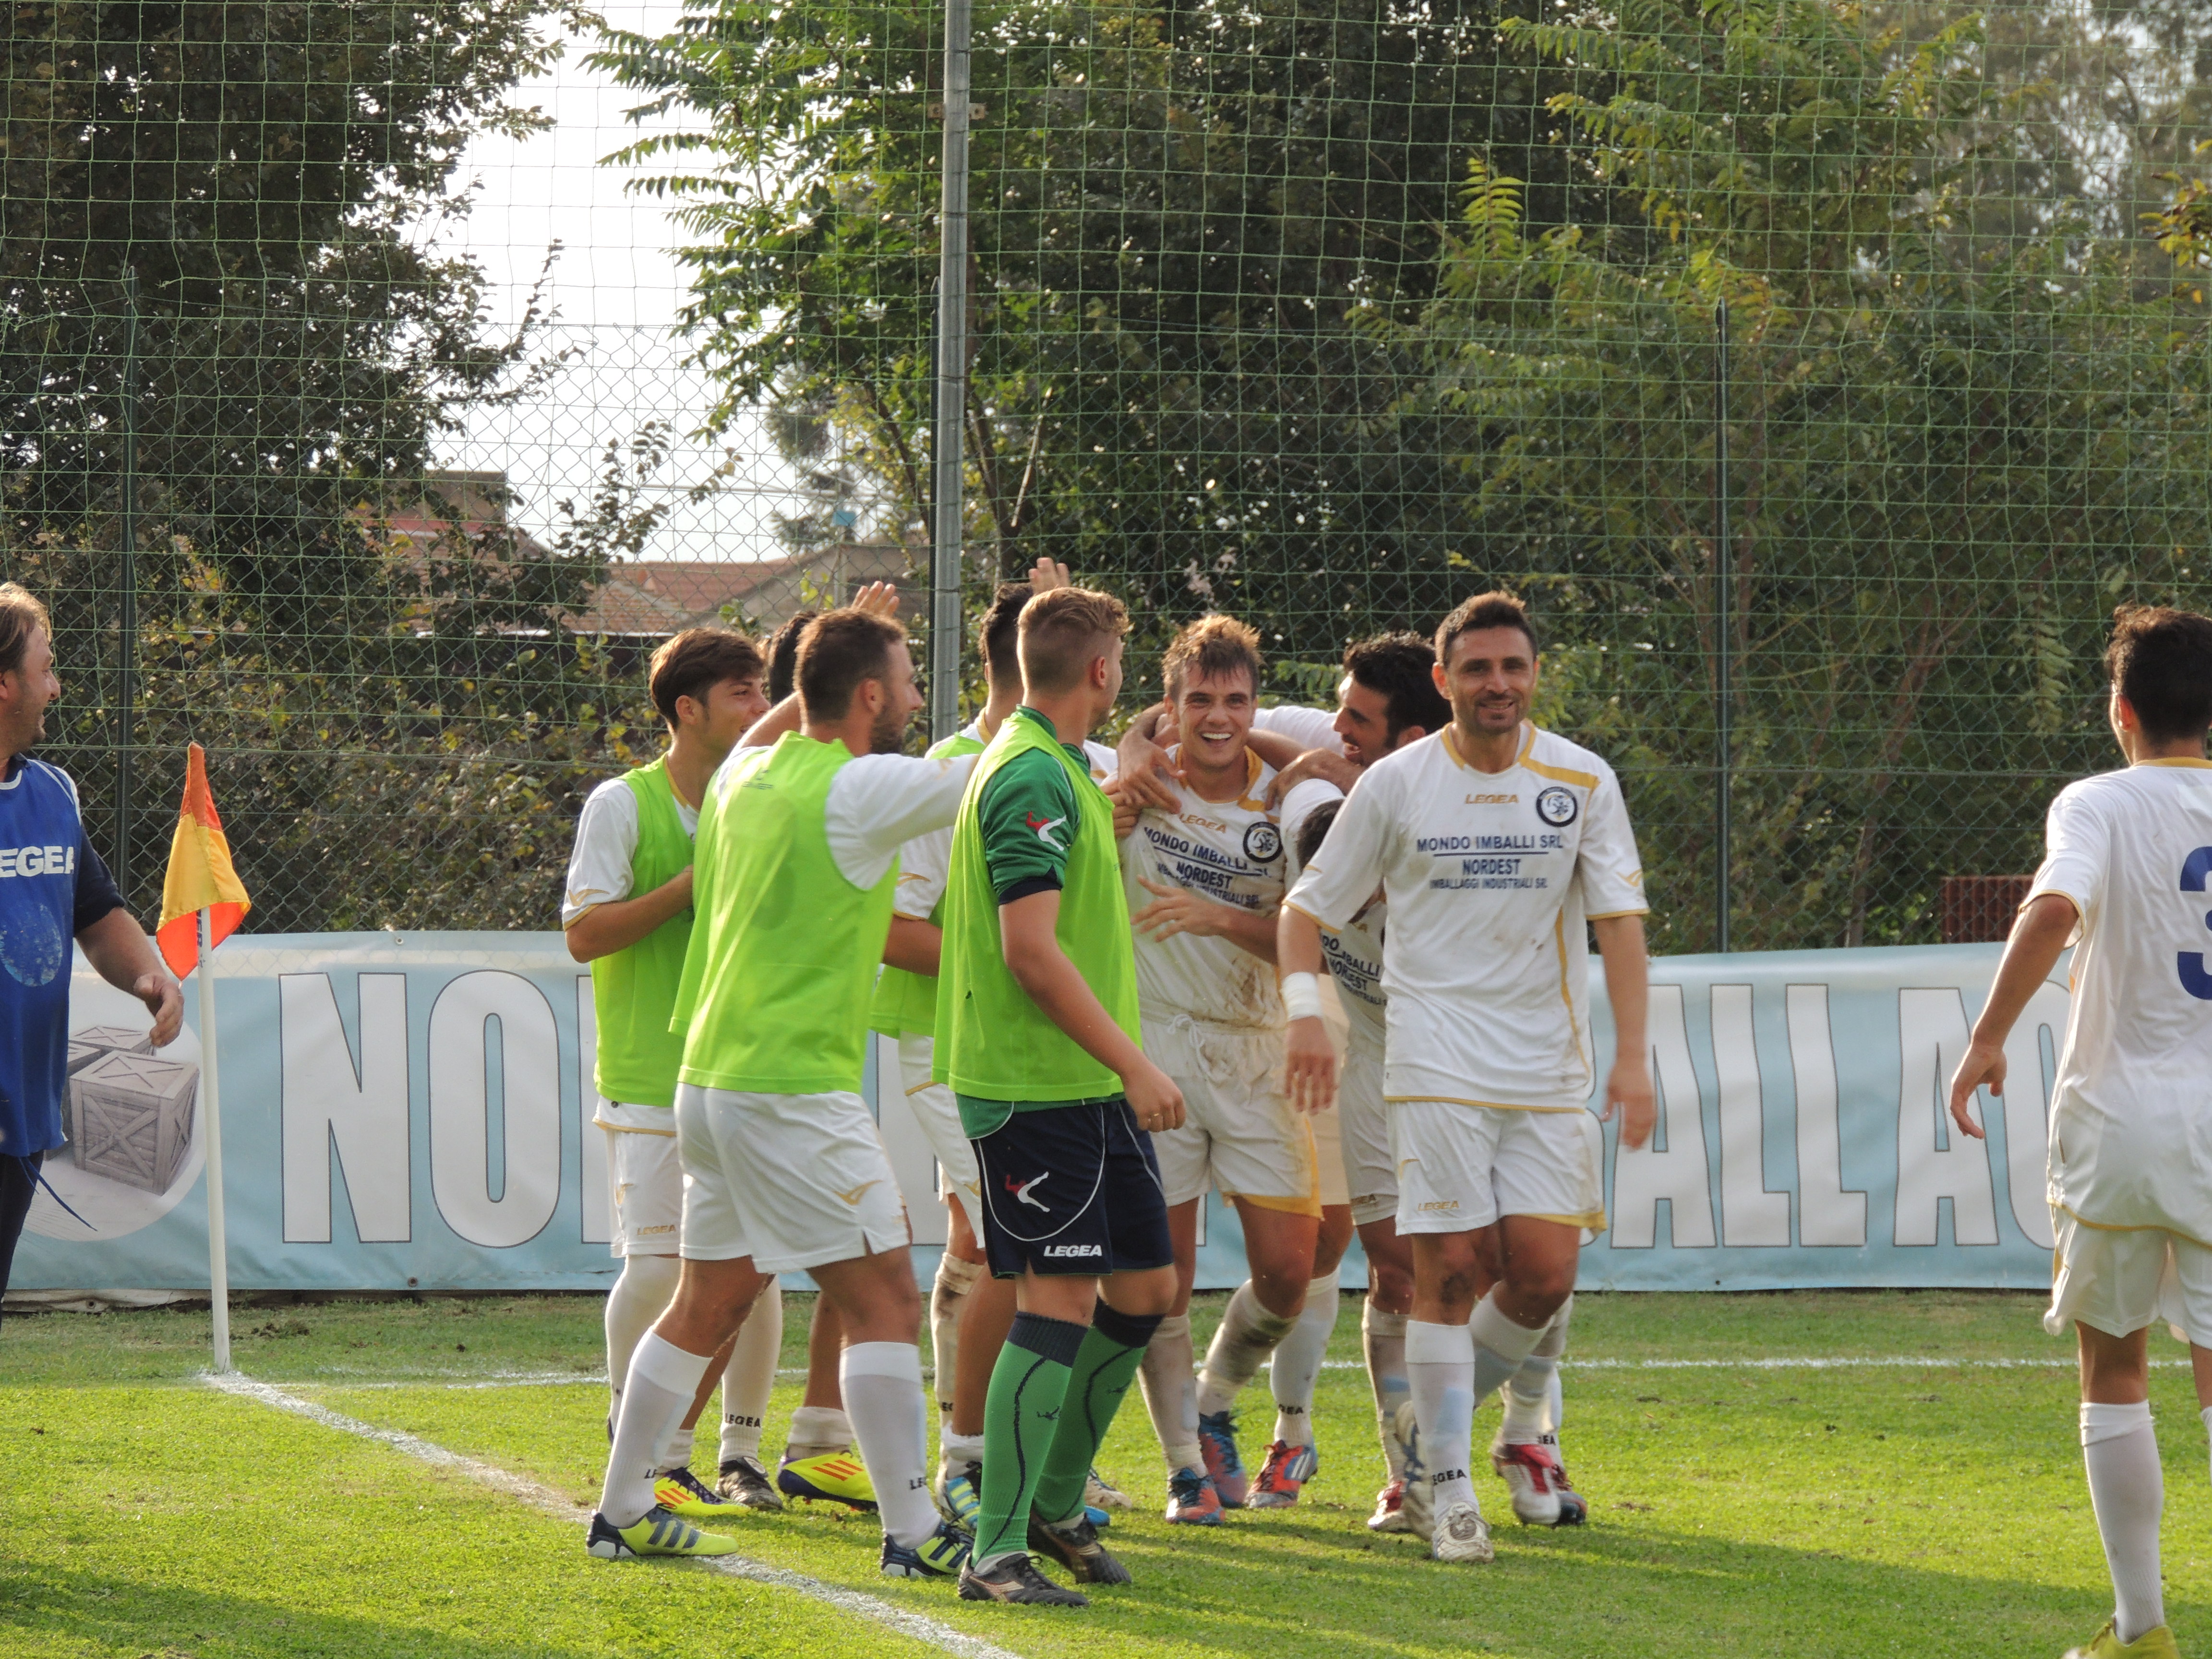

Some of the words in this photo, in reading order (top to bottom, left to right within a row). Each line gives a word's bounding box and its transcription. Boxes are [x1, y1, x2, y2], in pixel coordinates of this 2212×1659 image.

[1465, 793, 1520, 804] LEGEA
[1178, 813, 1226, 834] LEGEA
[1417, 836, 1470, 852] MONDO
[1476, 835, 1534, 850] IMBALLI
[1539, 834, 1563, 849] SRL
[1192, 843, 1248, 870] IMBALLI
[1176, 861, 1233, 889] NORDEST
[1462, 858, 1521, 876] NORDEST
[1418, 1201, 1460, 1212] LEGEA
[637, 1224, 676, 1236] LEGEA
[1043, 1245, 1102, 1257] LEGEA
[725, 1413, 761, 1428] LEGEA
